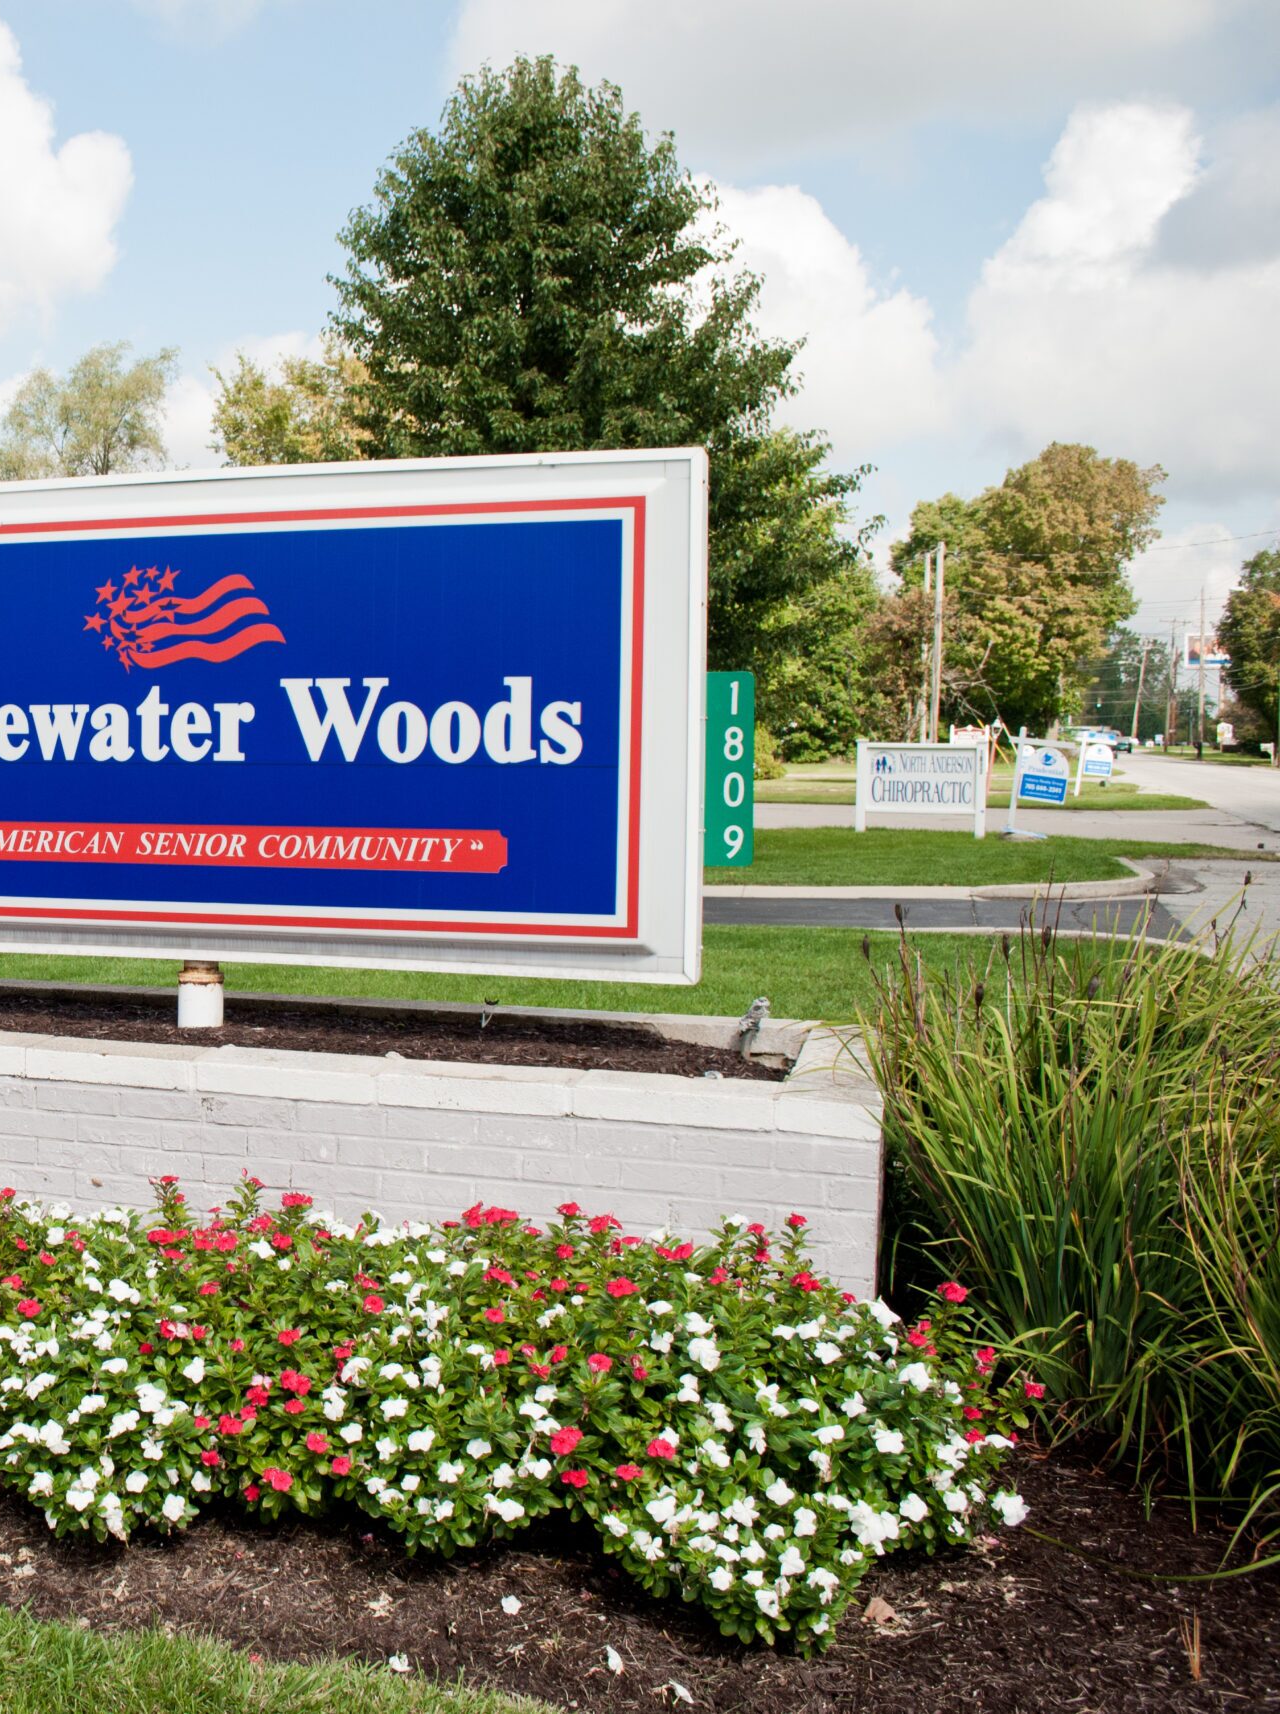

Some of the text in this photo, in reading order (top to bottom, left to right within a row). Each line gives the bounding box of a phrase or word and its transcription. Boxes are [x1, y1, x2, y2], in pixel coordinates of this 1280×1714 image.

[279, 675, 583, 766] Woods
[871, 775, 972, 804] CHIROPRACTIC
[135, 831, 247, 858] SENIOR
